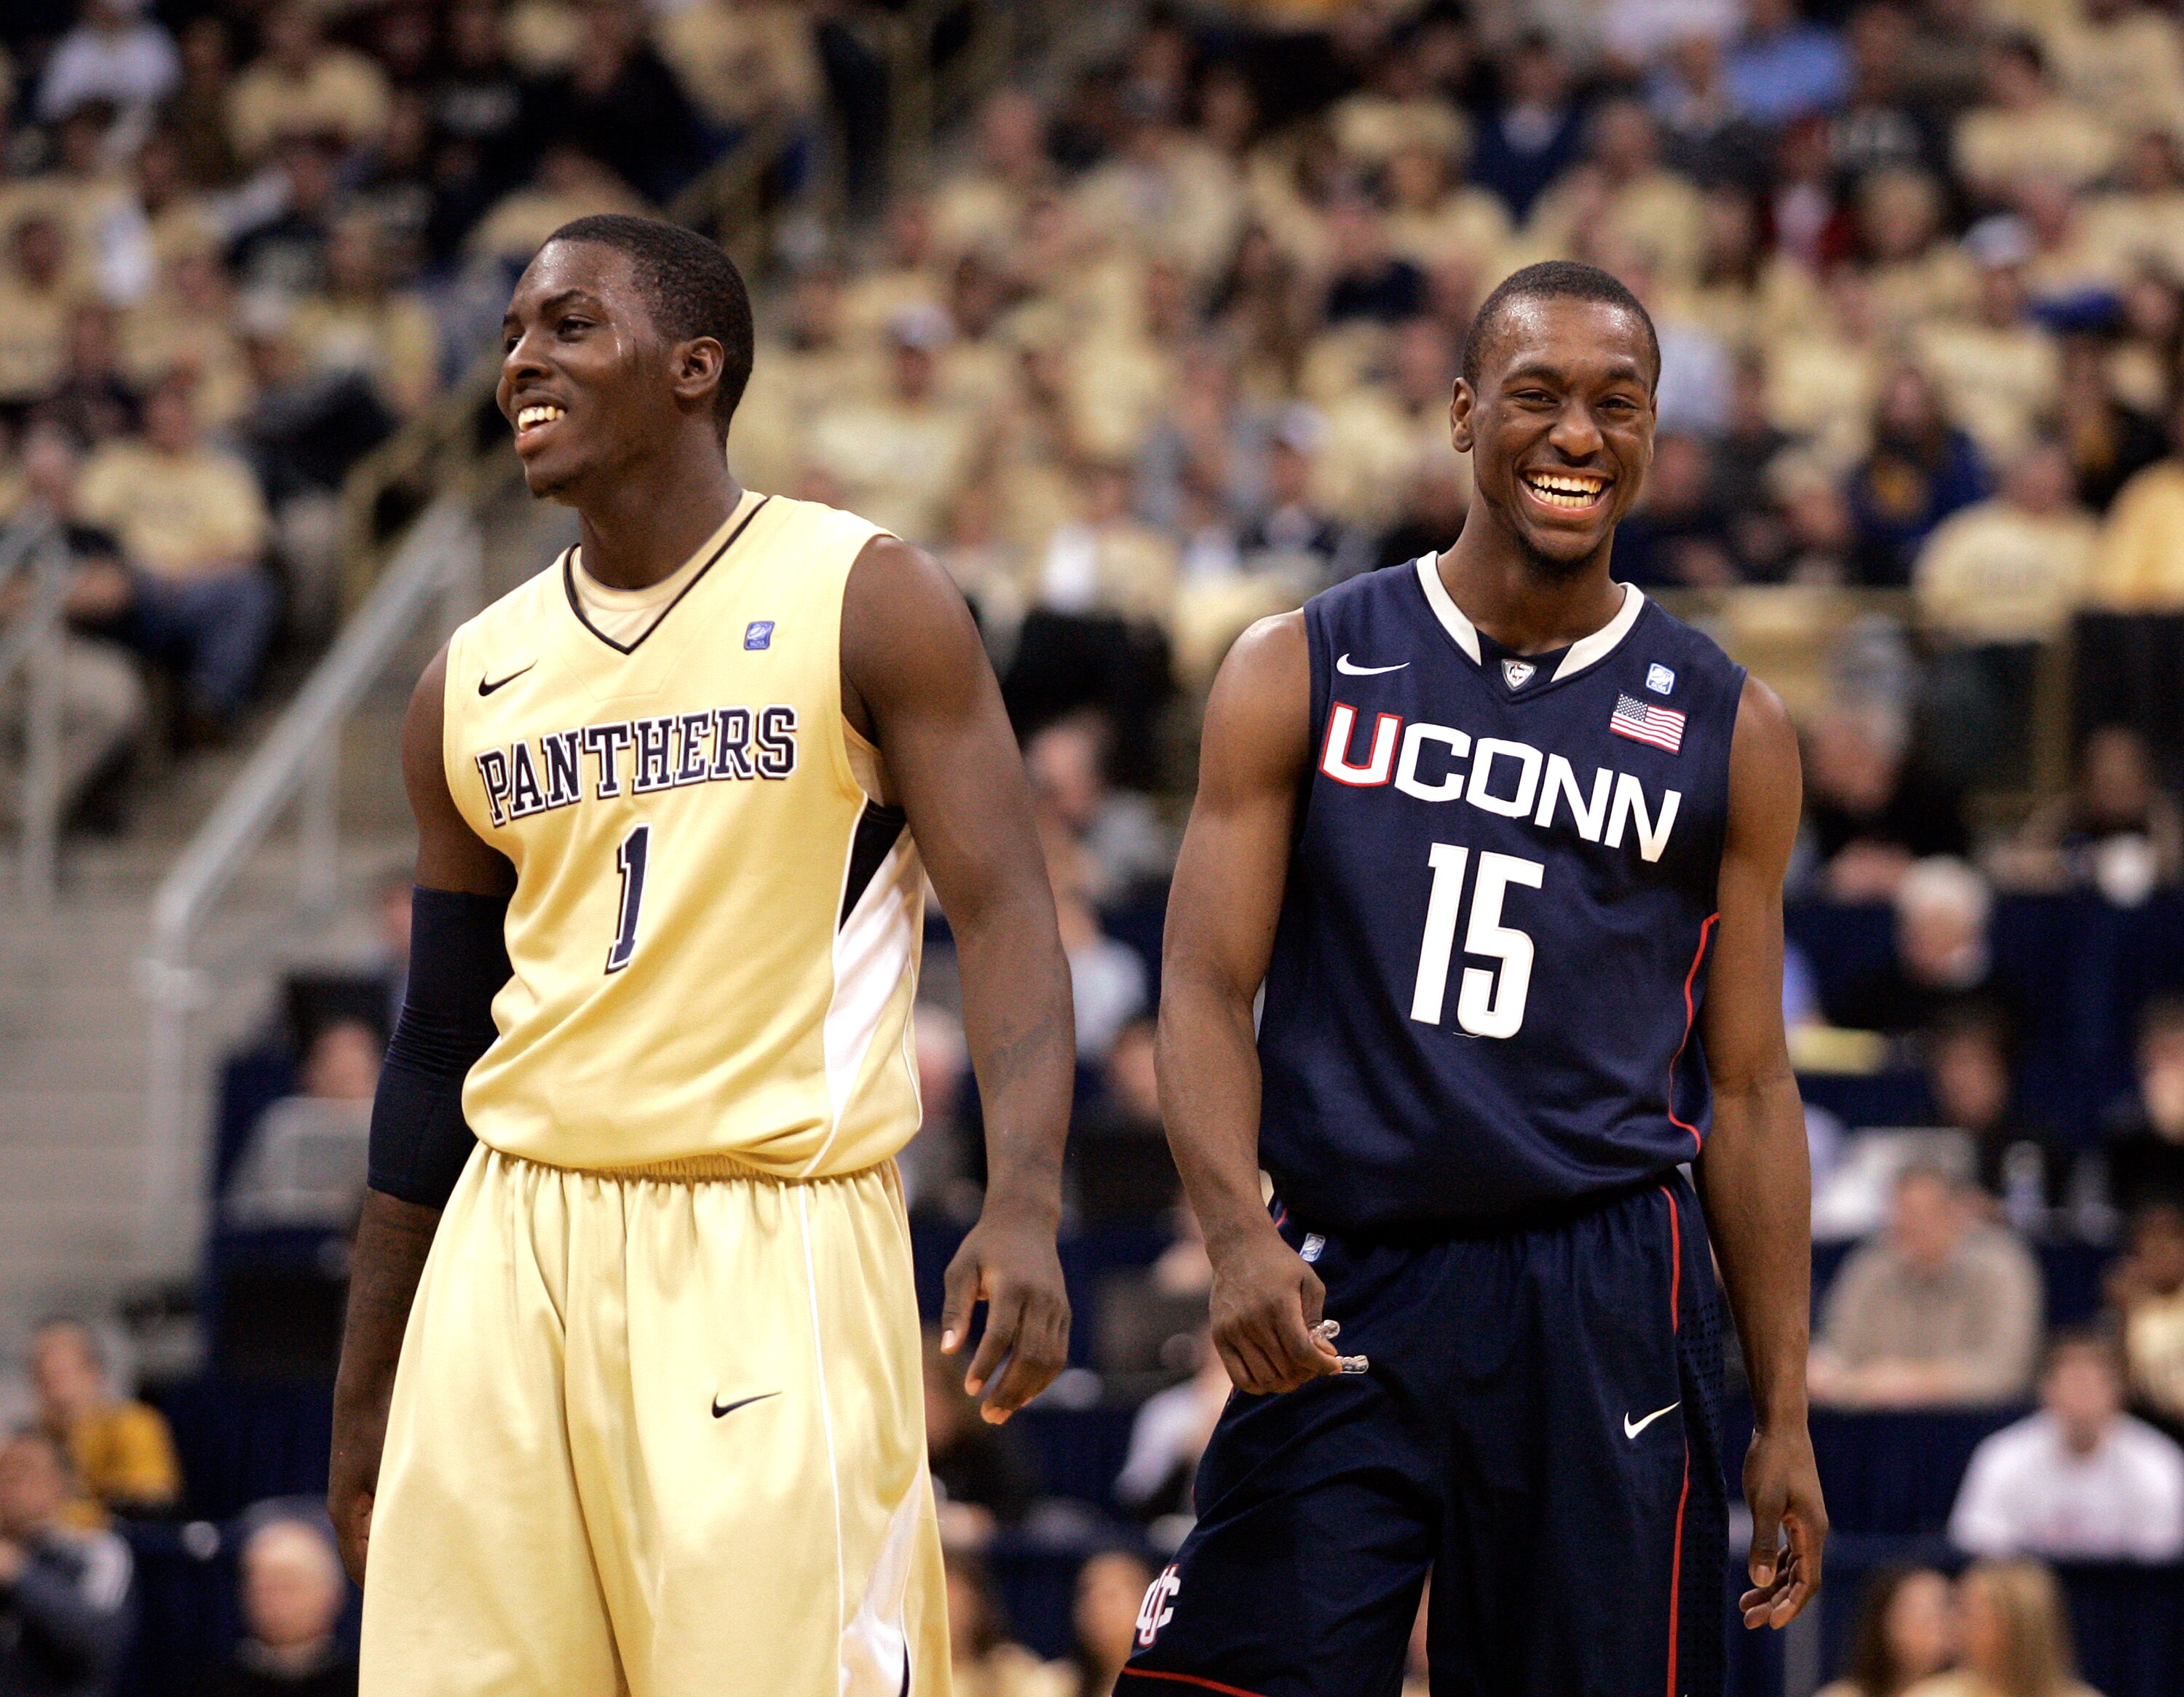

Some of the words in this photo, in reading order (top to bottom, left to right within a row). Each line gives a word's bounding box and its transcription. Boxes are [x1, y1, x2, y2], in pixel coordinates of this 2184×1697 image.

[475, 703, 799, 827] PANTHERS
[1318, 701, 1682, 863] UCONN
[604, 822, 652, 975] 1
[1410, 842, 1545, 1039] 15
